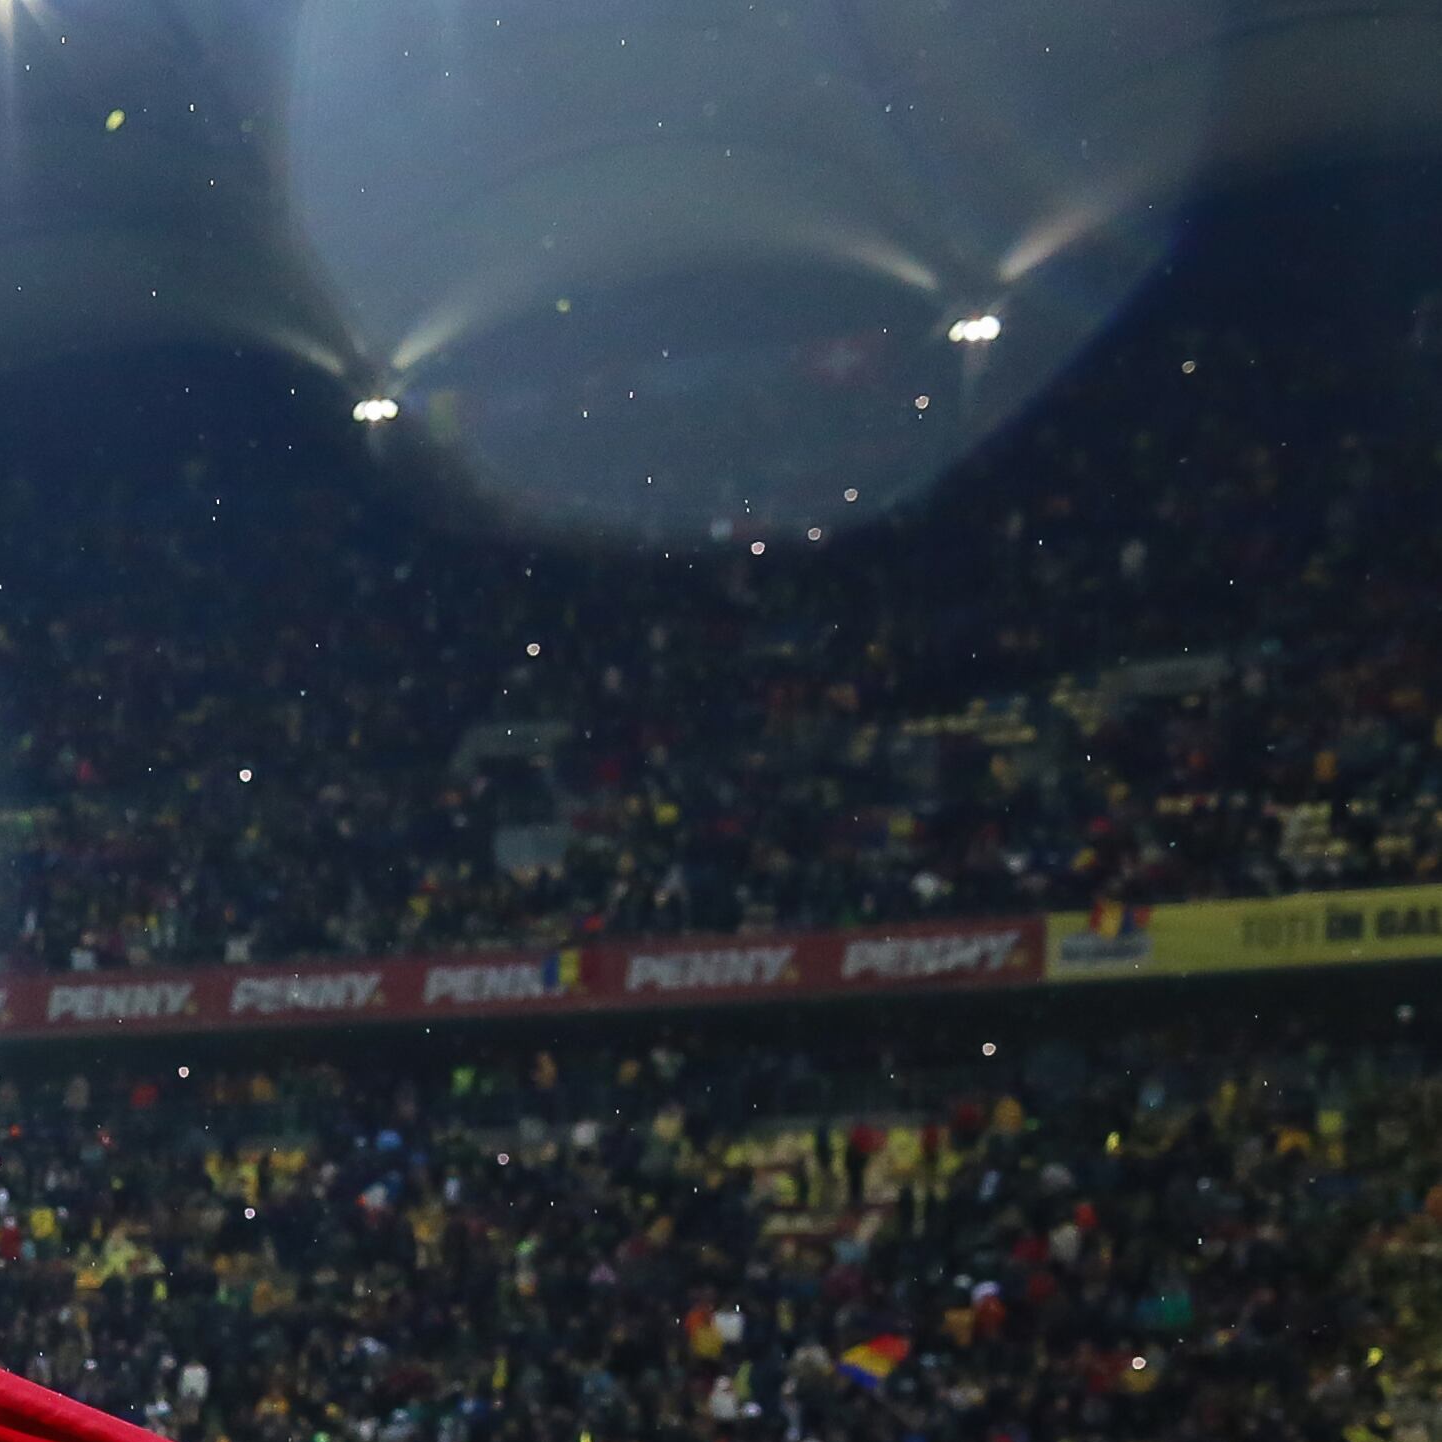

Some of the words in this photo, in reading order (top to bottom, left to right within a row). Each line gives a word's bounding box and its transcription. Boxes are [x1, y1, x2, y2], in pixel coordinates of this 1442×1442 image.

[423, 962, 569, 1004] PENN
[625, 945, 796, 991] PENNY
[48, 983, 193, 1021] PENNY
[229, 972, 382, 1014] PENNY
